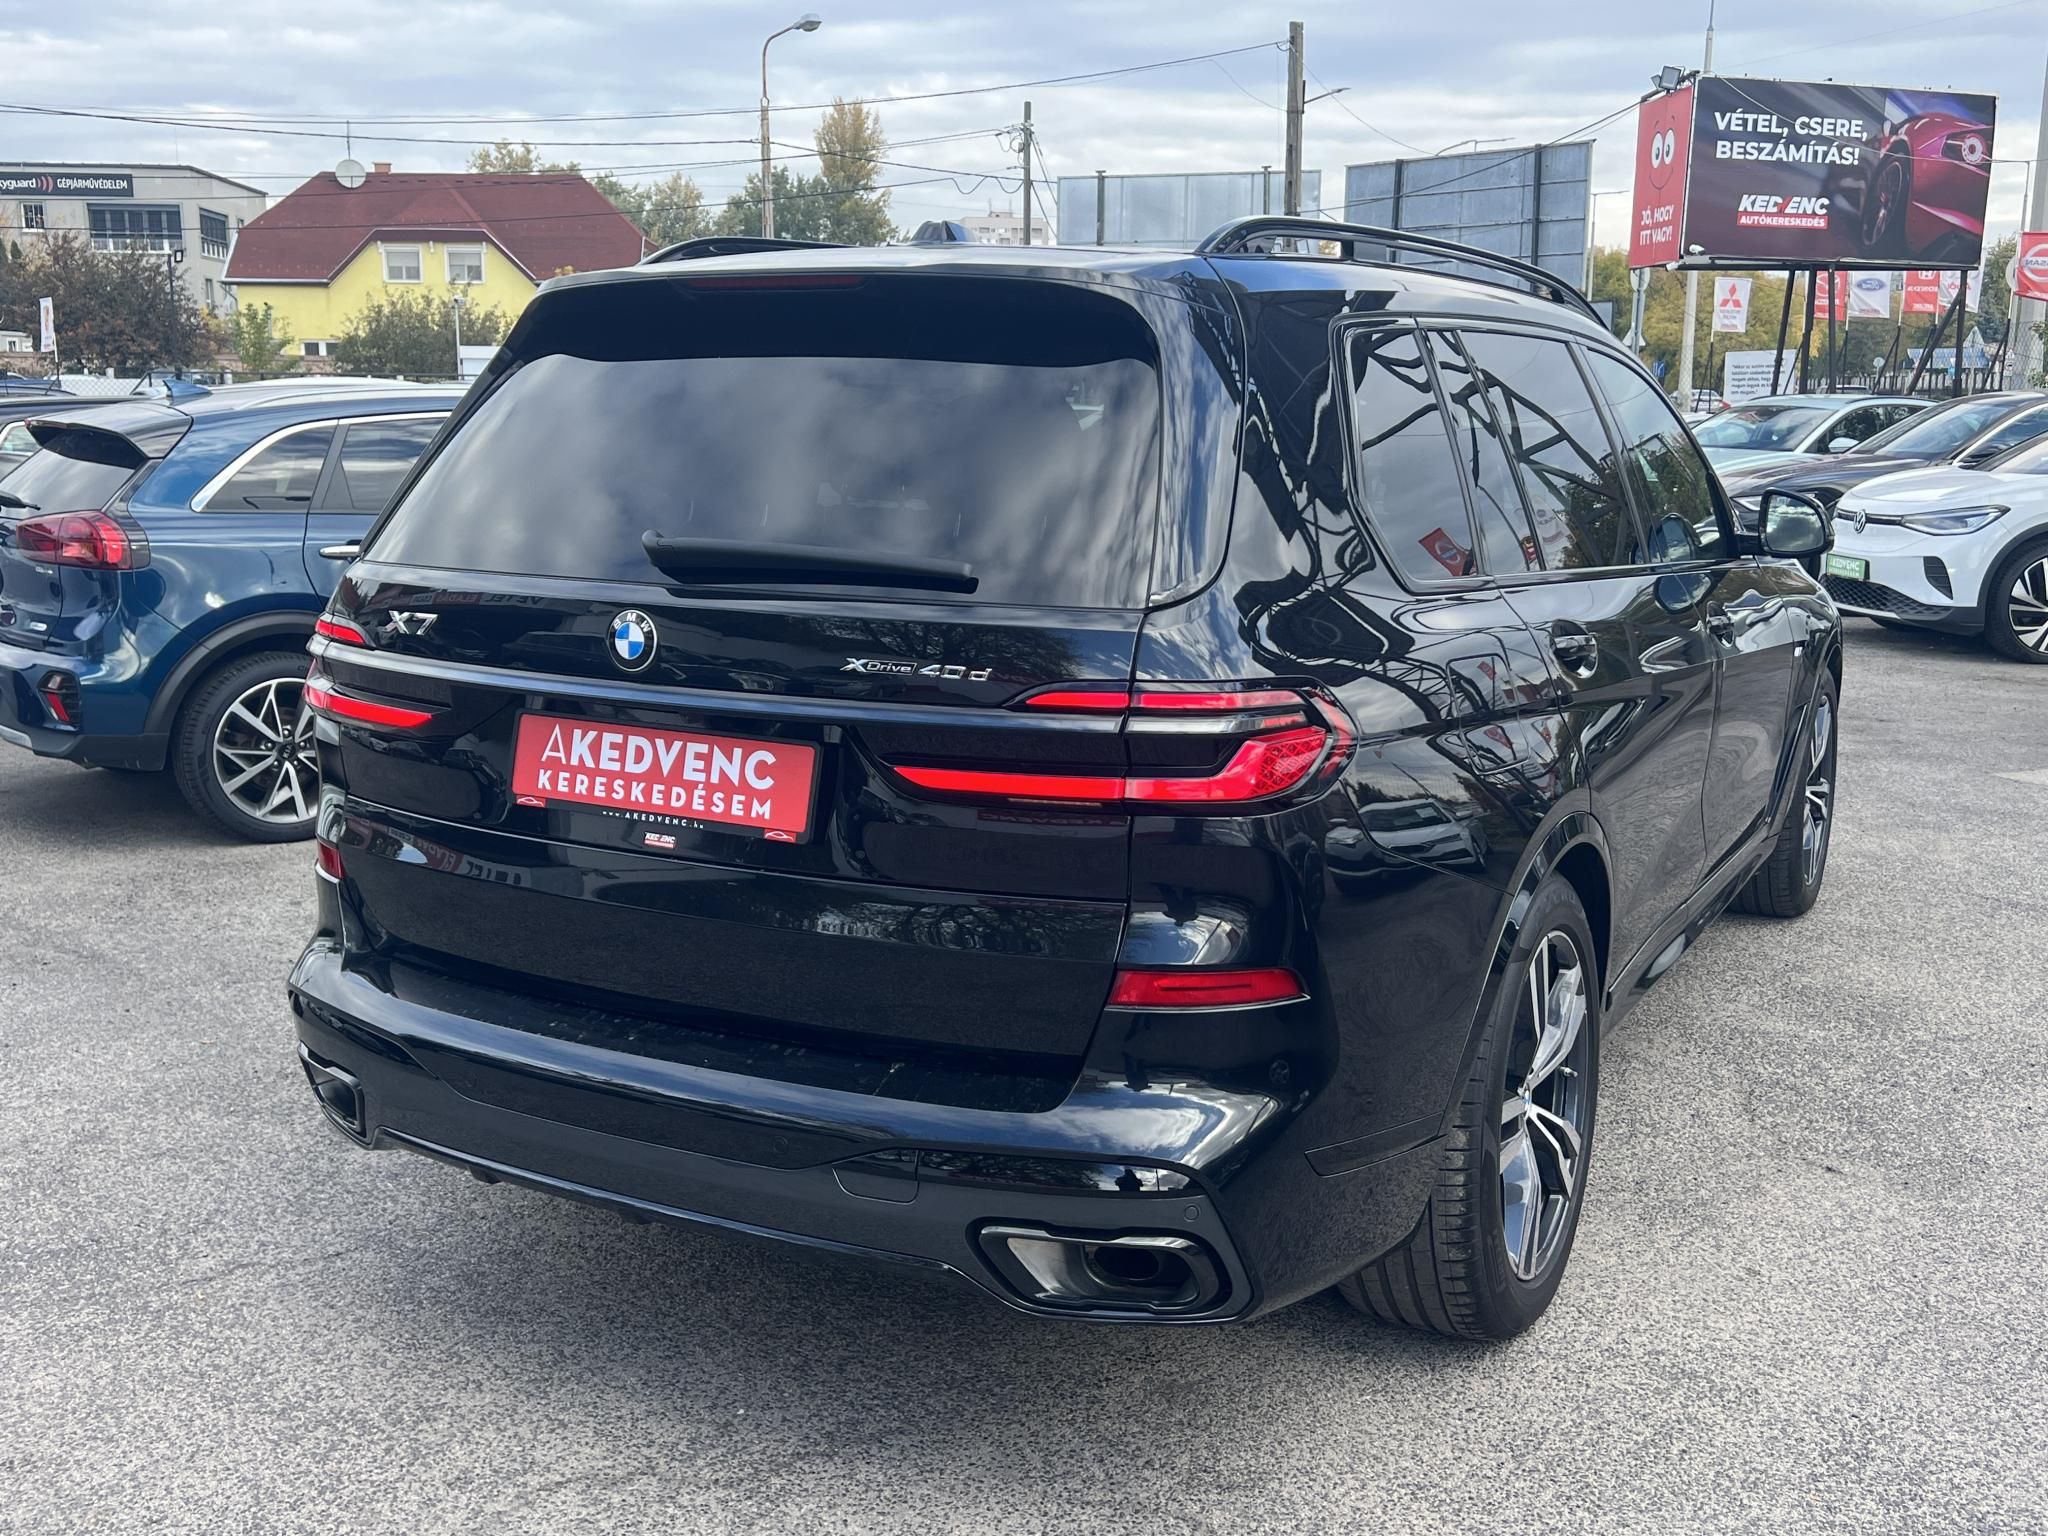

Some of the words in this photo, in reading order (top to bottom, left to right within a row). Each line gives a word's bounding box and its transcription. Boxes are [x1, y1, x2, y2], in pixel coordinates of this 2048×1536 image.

[1714, 108, 1789, 137] VÉTEL,
[1794, 116, 1868, 142] CSERE,
[1715, 139, 1860, 166] BESZÁMÍTÁS!
[1653, 204, 1674, 224] HOGY
[1740, 215, 1825, 227] AUTÓKERESKEDÉS
[1639, 230, 1651, 246] ITT
[1652, 226, 1673, 244] VAGY!
[378, 609, 439, 636] X7
[613, 612, 652, 633] BMW
[541, 723, 777, 790] AKEDVENC
[537, 769, 772, 821] KERESKEDÉSEM
